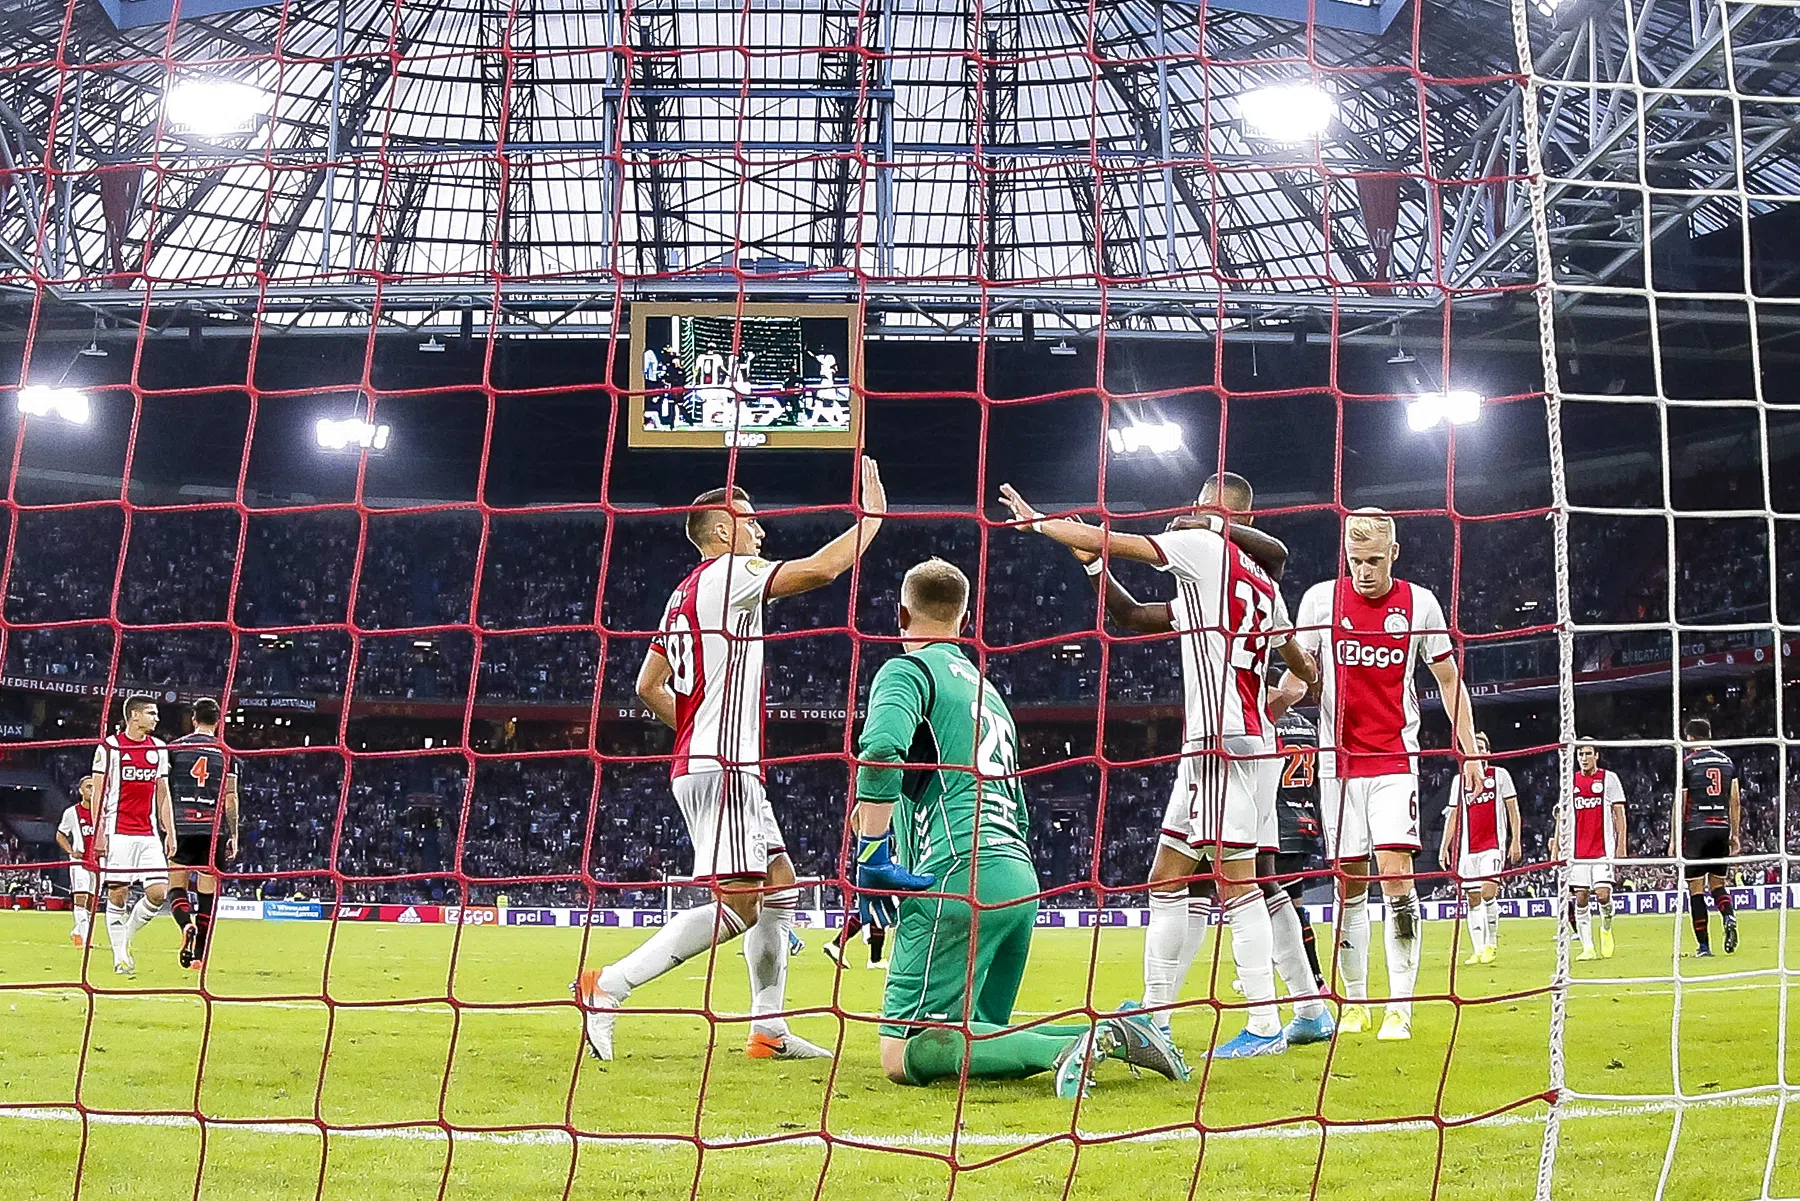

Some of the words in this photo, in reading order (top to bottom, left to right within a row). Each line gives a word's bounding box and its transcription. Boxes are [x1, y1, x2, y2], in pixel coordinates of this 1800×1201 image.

[1336, 640, 1404, 668] Ziggo
[619, 709, 636, 718] DE
[781, 710, 796, 719] DE
[190, 756, 209, 787] 4
[1706, 768, 1721, 796] 3
[1409, 790, 1417, 821] 6
[1531, 899, 1546, 916] pci
[1641, 895, 1652, 912] pci
[1735, 890, 1749, 909] pci
[1770, 892, 1783, 908] pc
[445, 906, 494, 925] Zggo
[516, 910, 541, 925] pci
[579, 911, 605, 926] pci
[642, 911, 667, 926] pci
[1036, 911, 1051, 924] ci
[1088, 910, 1113, 926] pci
[1211, 912, 1230, 925] pc
